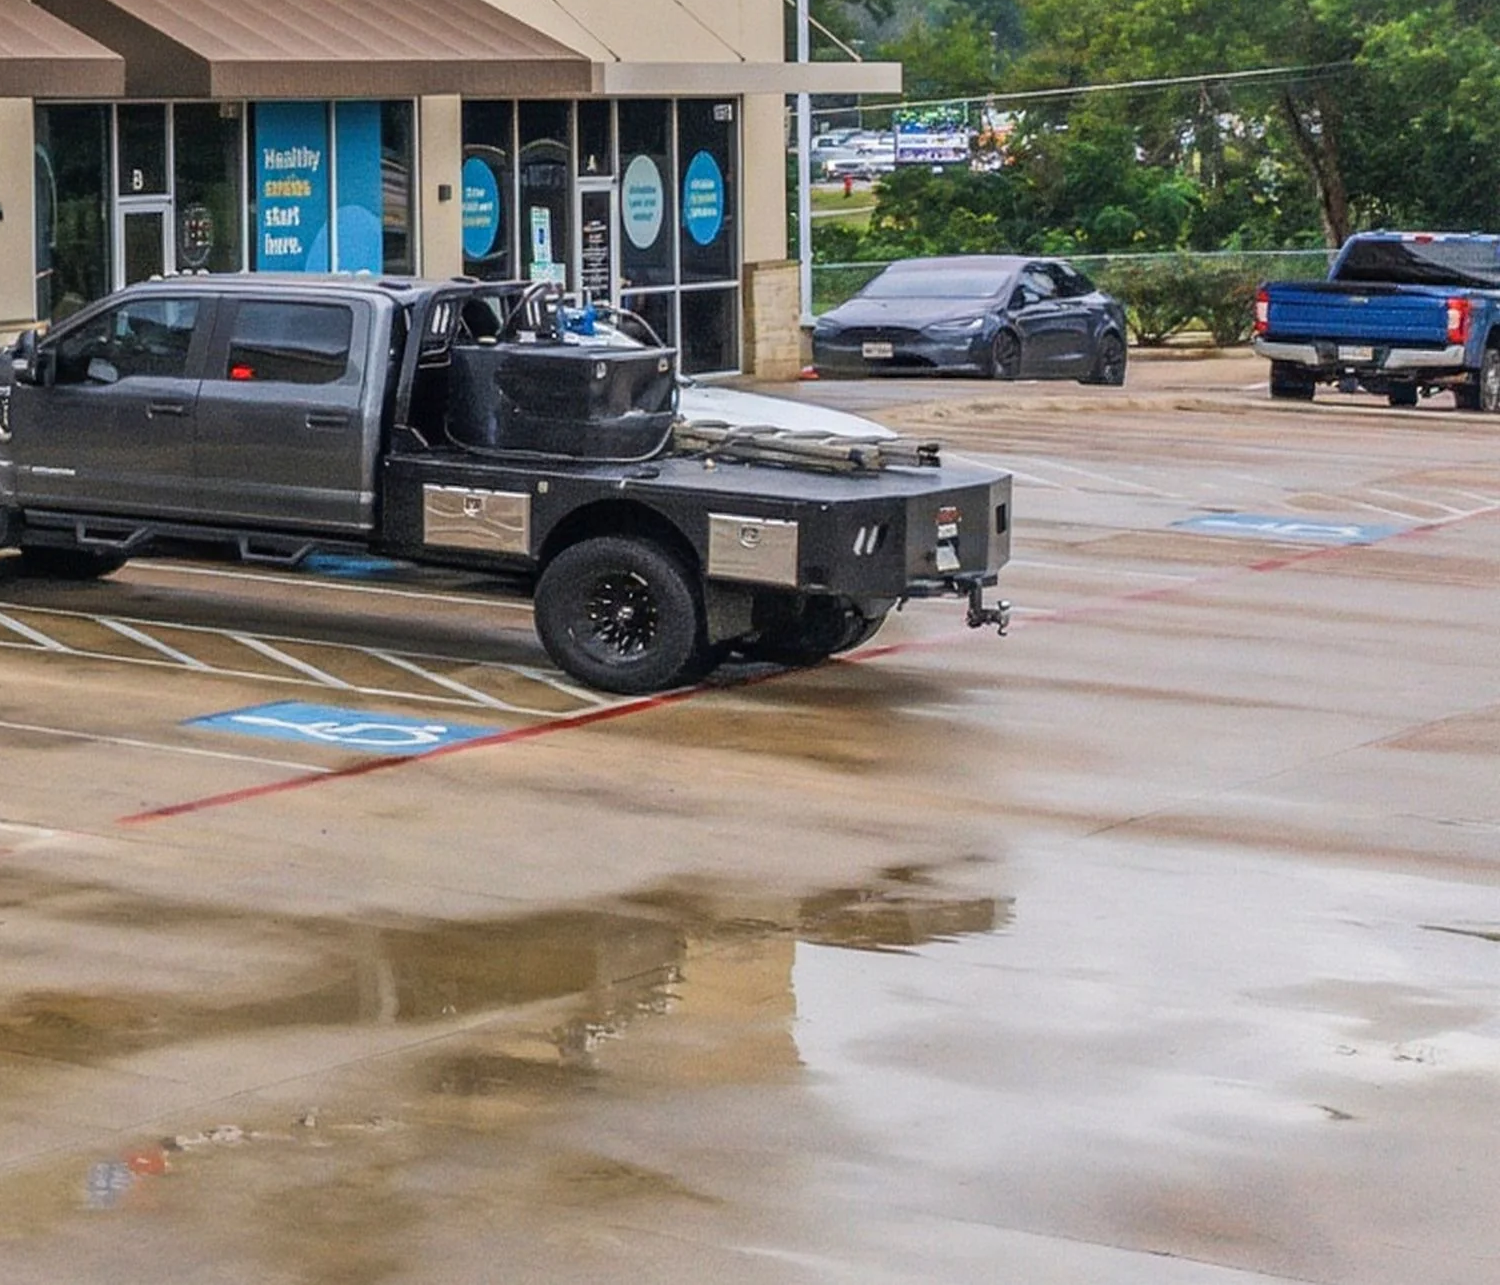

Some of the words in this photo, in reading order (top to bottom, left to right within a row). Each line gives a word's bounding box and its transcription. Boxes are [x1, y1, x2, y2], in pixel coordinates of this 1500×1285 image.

[263, 146, 321, 172] Healthy
[132, 168, 144, 191] B
[265, 206, 300, 227] start
